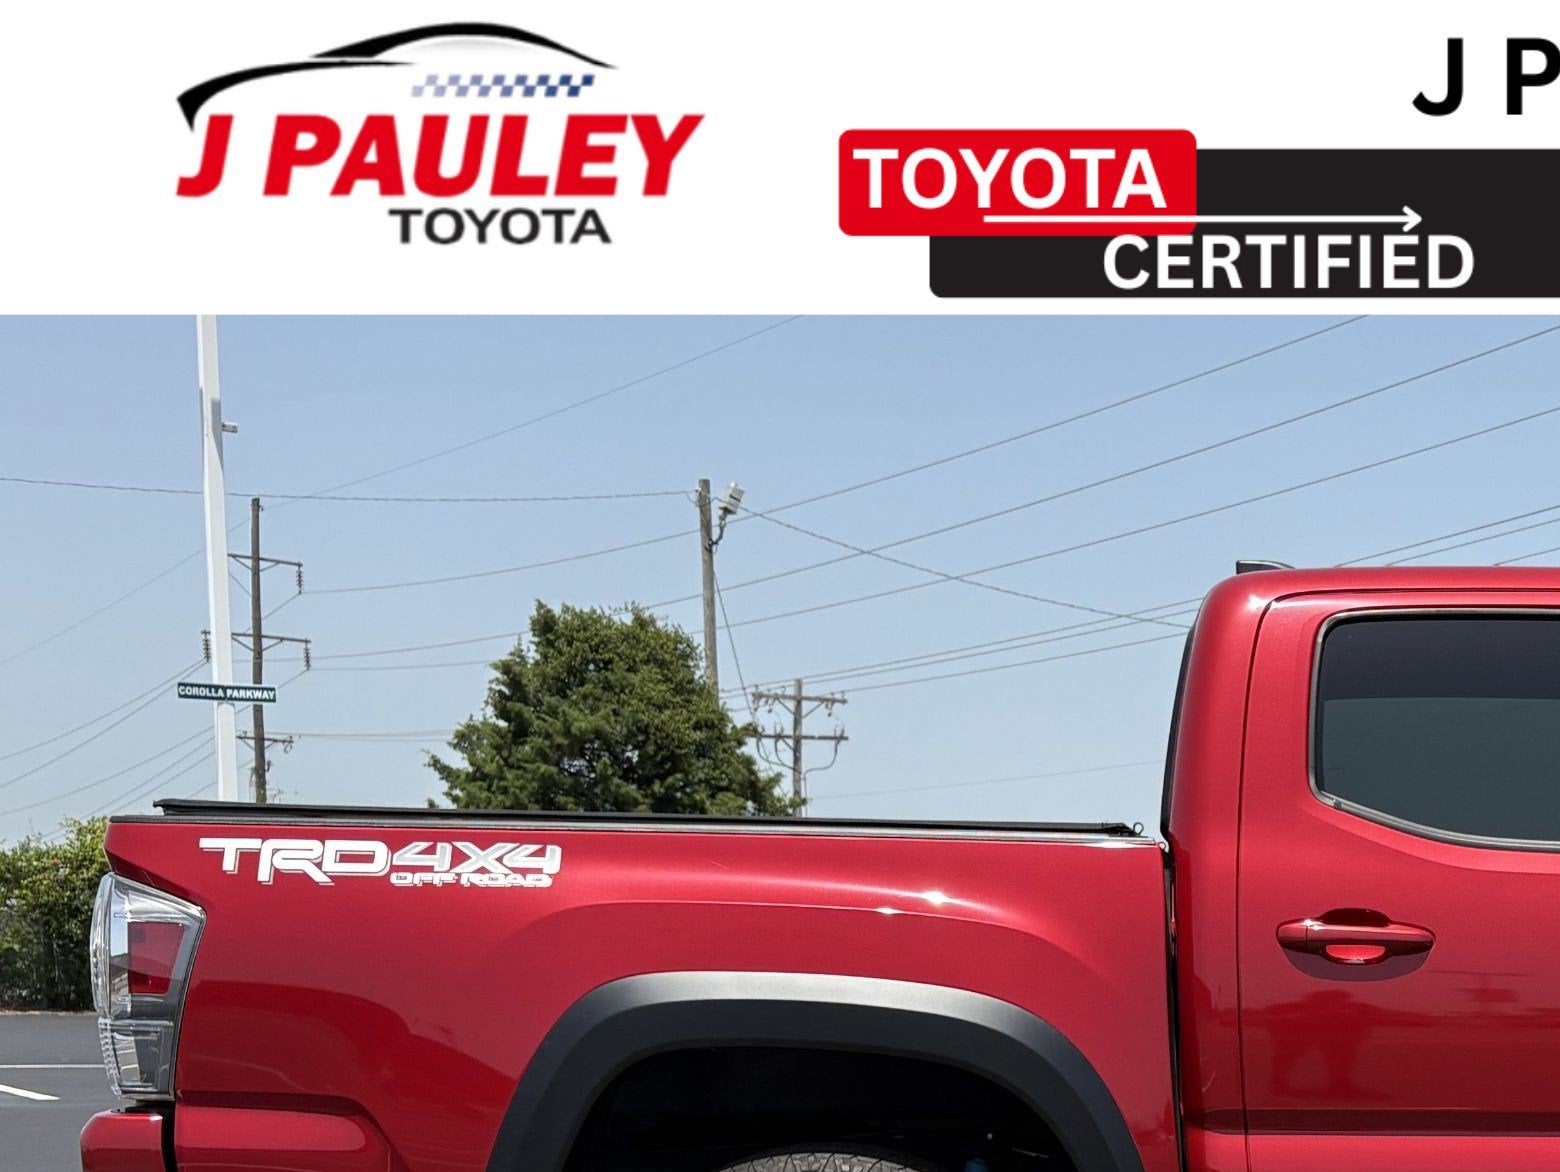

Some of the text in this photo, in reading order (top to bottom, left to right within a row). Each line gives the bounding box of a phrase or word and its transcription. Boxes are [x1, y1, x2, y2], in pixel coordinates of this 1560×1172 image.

[178, 686, 275, 700] COROLLA PARKWAY
[199, 838, 392, 886] TRD
